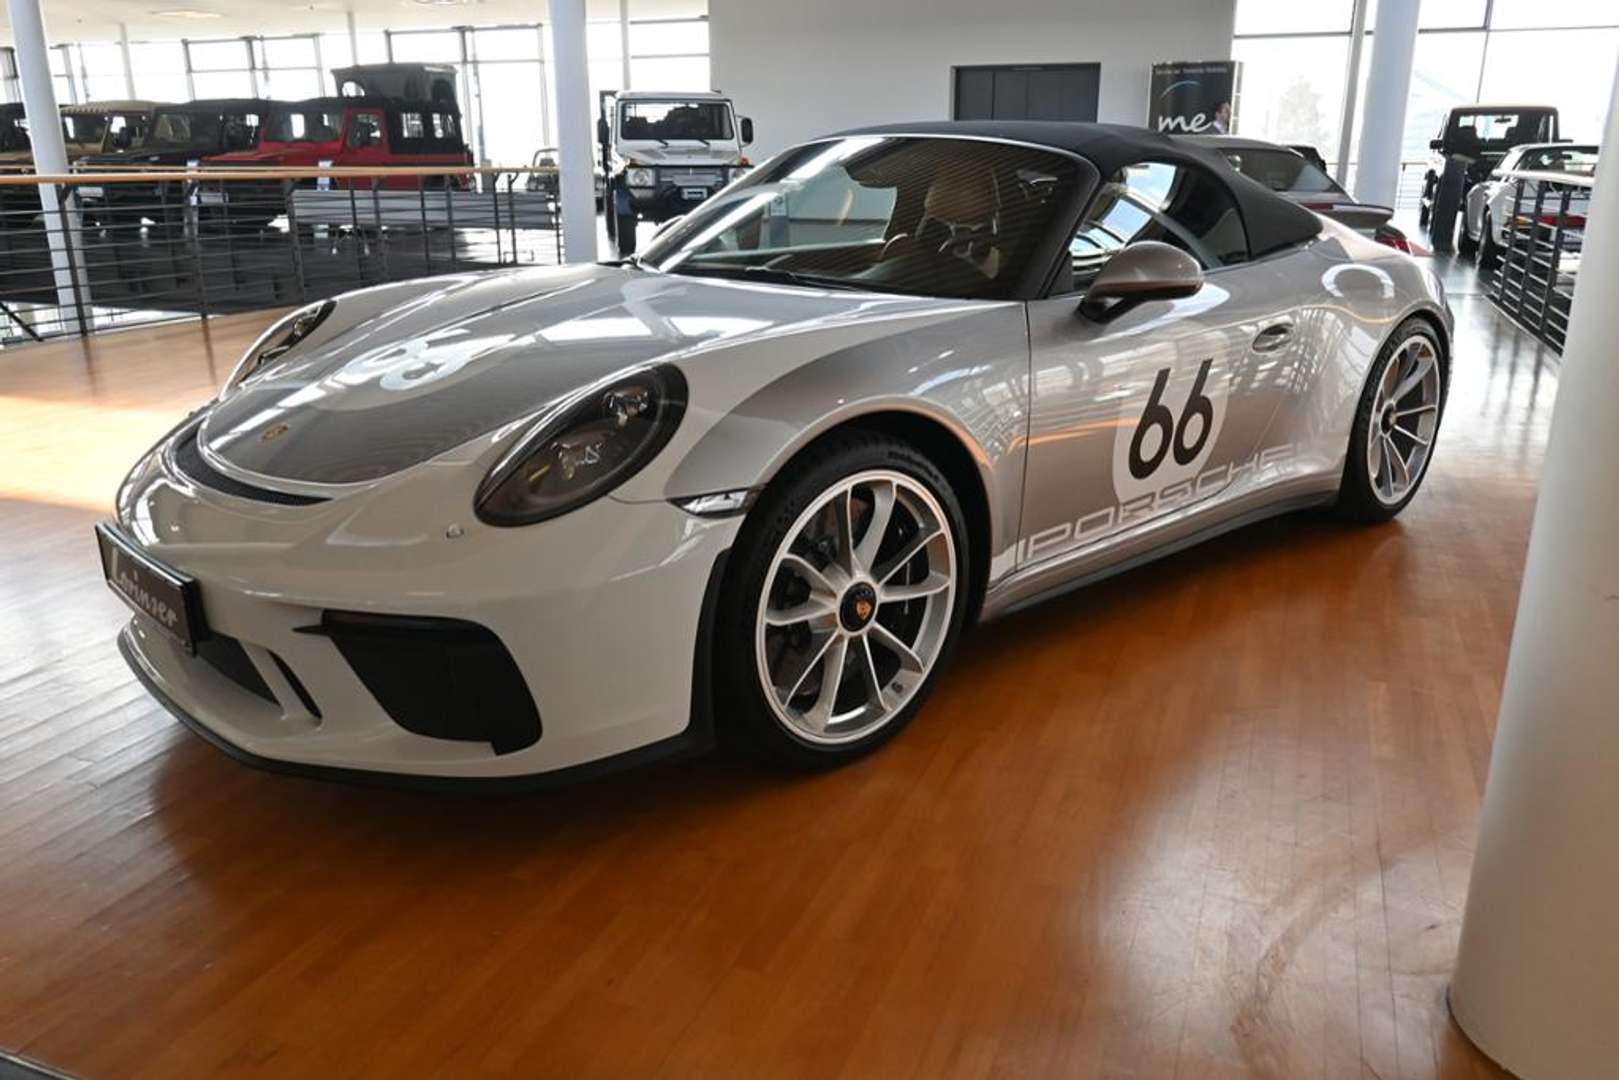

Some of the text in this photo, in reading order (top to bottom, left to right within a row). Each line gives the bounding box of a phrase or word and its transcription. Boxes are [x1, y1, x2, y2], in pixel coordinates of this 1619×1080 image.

[1158, 113, 1212, 132] me
[1128, 358, 1213, 480] 66
[1026, 443, 1294, 559] PORSCHE
